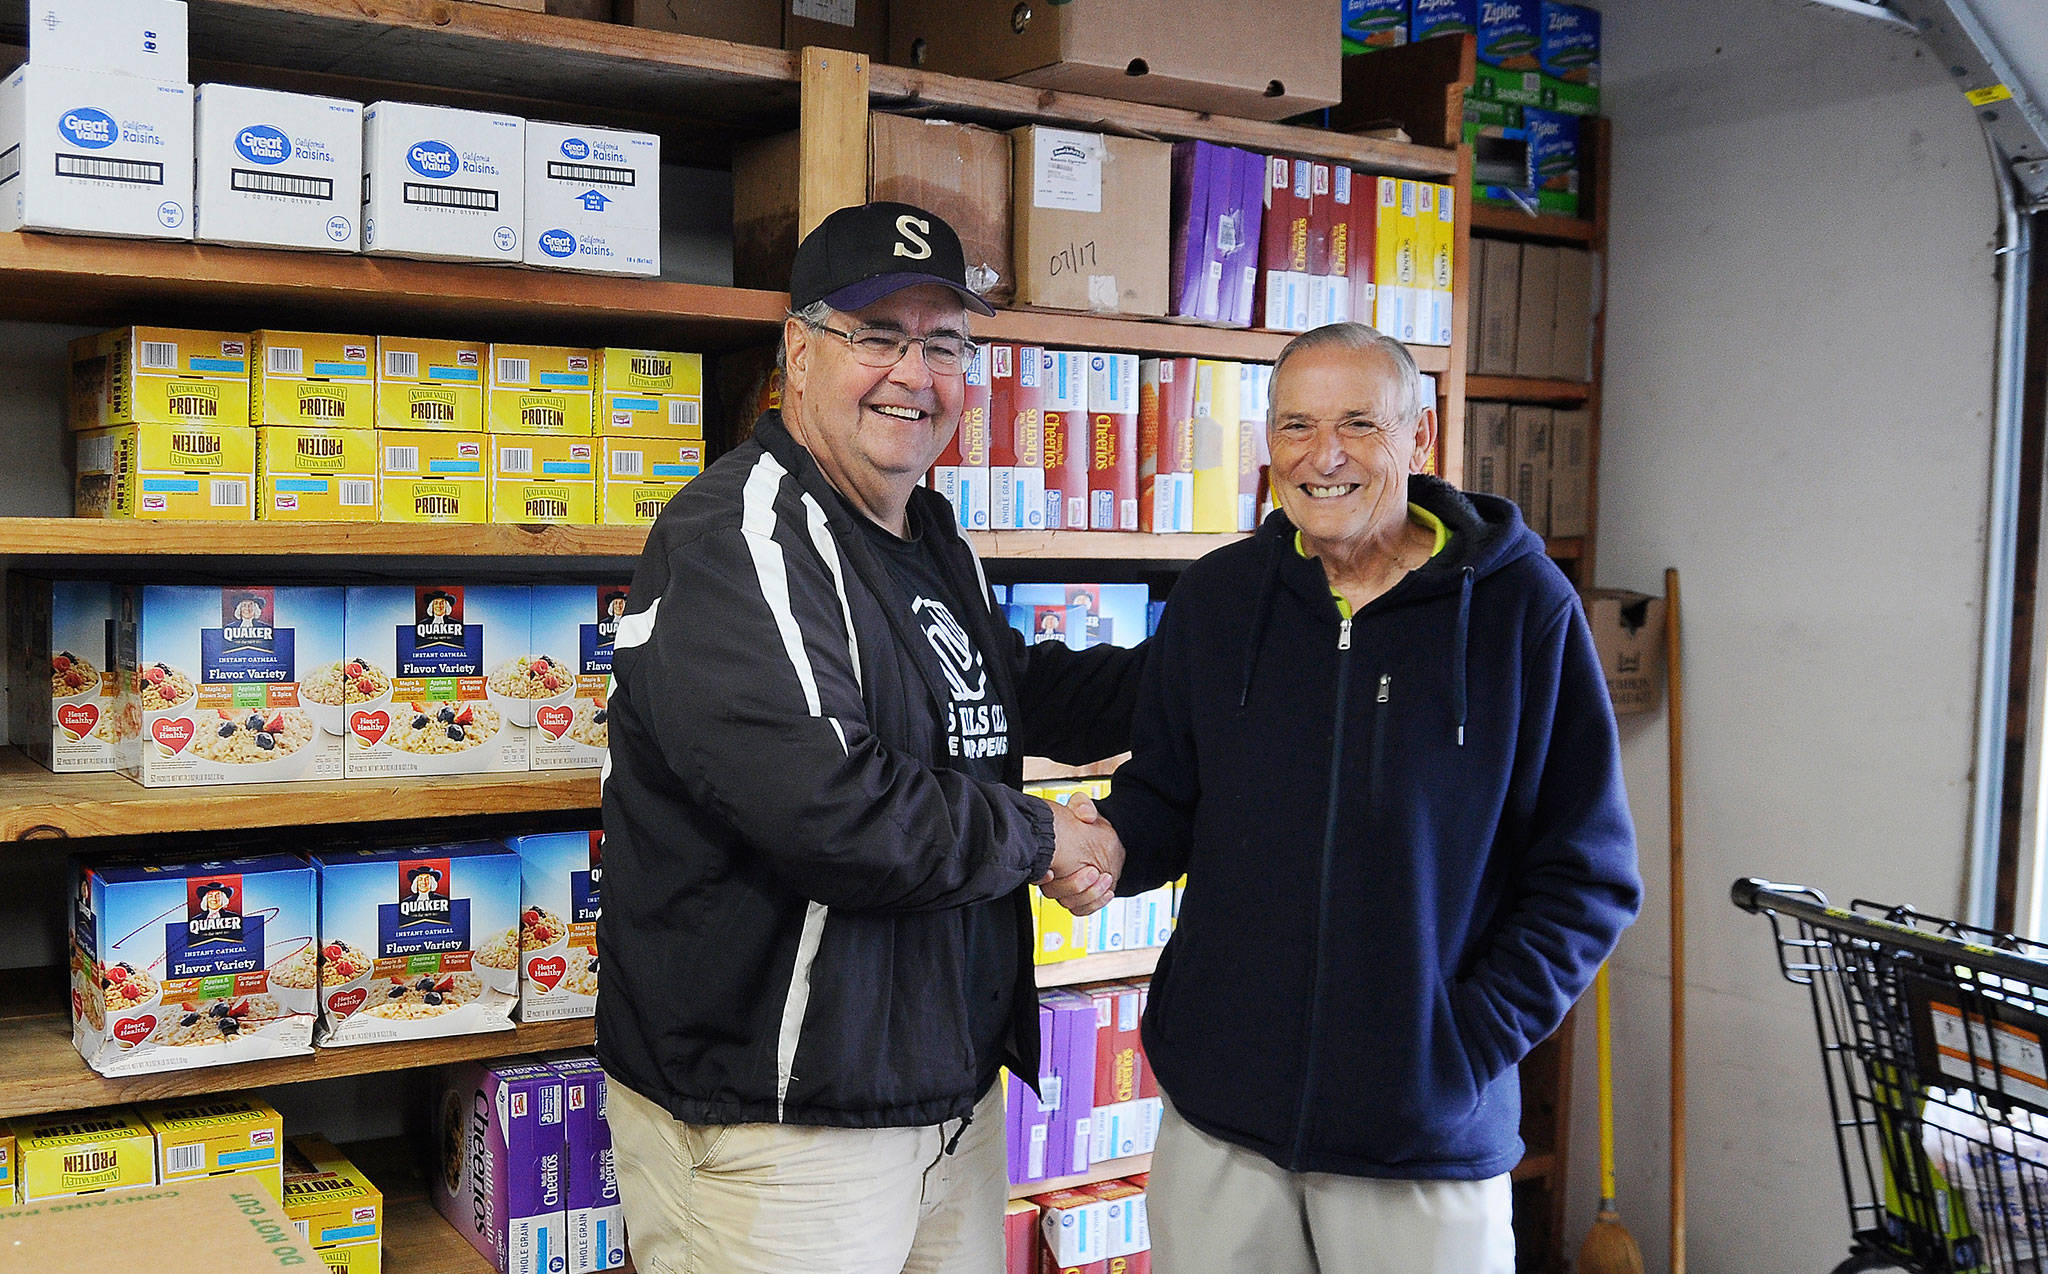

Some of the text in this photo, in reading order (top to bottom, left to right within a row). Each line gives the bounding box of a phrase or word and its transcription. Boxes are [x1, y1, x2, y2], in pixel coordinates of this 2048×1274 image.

[1482, 3, 1522, 24] Ziploc
[64, 114, 110, 133] Great
[122, 120, 154, 132] California
[75, 130, 113, 143] Value
[122, 131, 161, 146] Raisins
[240, 132, 283, 150] Great
[295, 137, 326, 150] California
[251, 147, 283, 159] Value
[295, 148, 330, 162] Raisins
[411, 147, 451, 163] Great
[462, 151, 490, 164] California
[592, 149, 624, 163] Raisins
[422, 161, 451, 173] Value
[462, 161, 495, 176] Raisins
[162, 206, 179, 216] Dept.
[166, 216, 175, 224] 95
[330, 221, 347, 231] Dept.
[334, 230, 343, 238] 95
[497, 232, 512, 240] Dept.
[543, 234, 571, 246] Great
[893, 215, 932, 260] S
[579, 244, 610, 257] Raisins
[1295, 217, 1307, 271] Cheerios
[1050, 241, 1097, 277] 07/17
[631, 358, 671, 375] PROTEIN
[169, 384, 217, 397] NATURE VALLEY
[299, 386, 345, 399] NATURE VALLEY
[410, 390, 455, 403] NATURE VALLEY
[169, 397, 217, 416] PROTEIN
[300, 398, 345, 417] PROTEIN
[520, 397, 565, 409] NATURE VALLEY
[411, 402, 454, 421] PROTEIN
[521, 408, 564, 426] PROTEIN
[172, 434, 221, 453] PROTEIN
[968, 407, 984, 465] Cheerios
[1023, 408, 1038, 466] Cheerios
[1044, 413, 1060, 469] Cheerios
[1095, 415, 1112, 471] Cheerios
[297, 437, 343, 457] PROTEIN
[1180, 418, 1195, 472] Cheerios
[116, 439, 128, 510] PROTEIN
[946, 471, 955, 495] GRAIN
[414, 485, 460, 498] NATURE VALLEY
[524, 487, 569, 499] NATURE VALLEY
[1001, 471, 1009, 524] WHOLE GRAIN
[415, 496, 458, 515] PROTEIN
[525, 499, 567, 517] PROTEIN
[224, 626, 273, 641] QUAKER
[416, 622, 463, 637] QUAKER
[209, 668, 287, 681] Flavor Variety
[403, 663, 476, 675] Flavor Variety
[64, 716, 95, 726] Healthy
[67, 710, 88, 719] Heart
[542, 717, 569, 726] Healthy
[545, 712, 564, 720] Heart
[357, 723, 385, 731] Healthy
[159, 731, 190, 740] Healthy
[400, 899, 449, 915] QUAKER
[189, 916, 242, 934] QUAKER
[424, 928, 454, 936] OATMEAL
[184, 946, 247, 958] INSTANT OATMEAL
[386, 940, 463, 954] Flavor Variety
[174, 959, 256, 975] Flavor Variety
[534, 968, 561, 977] Healthy
[333, 999, 362, 1009] Healthy
[337, 994, 357, 1003] Heart
[119, 1025, 151, 1037] Healthy
[123, 1021, 146, 1030] Heart
[1119, 1048, 1134, 1102] Cheerios
[32, 1119, 128, 1139] PROTEIN
[63, 1150, 117, 1173] PROTEIN
[473, 1088, 490, 1237] Cheerios
[65, 1169, 118, 1186] NATURE VALLEY
[543, 1154, 559, 1206] Cheerios
[49, 1191, 180, 1213] CONTAINS
[485, 1150, 494, 1245] Multi Grain
[229, 1192, 305, 1266] DO NOT CUT
[520, 1222, 529, 1247] GRAIN
[579, 1213, 588, 1268] WHOLE GRAIN
[325, 1252, 349, 1261] VALLEY
